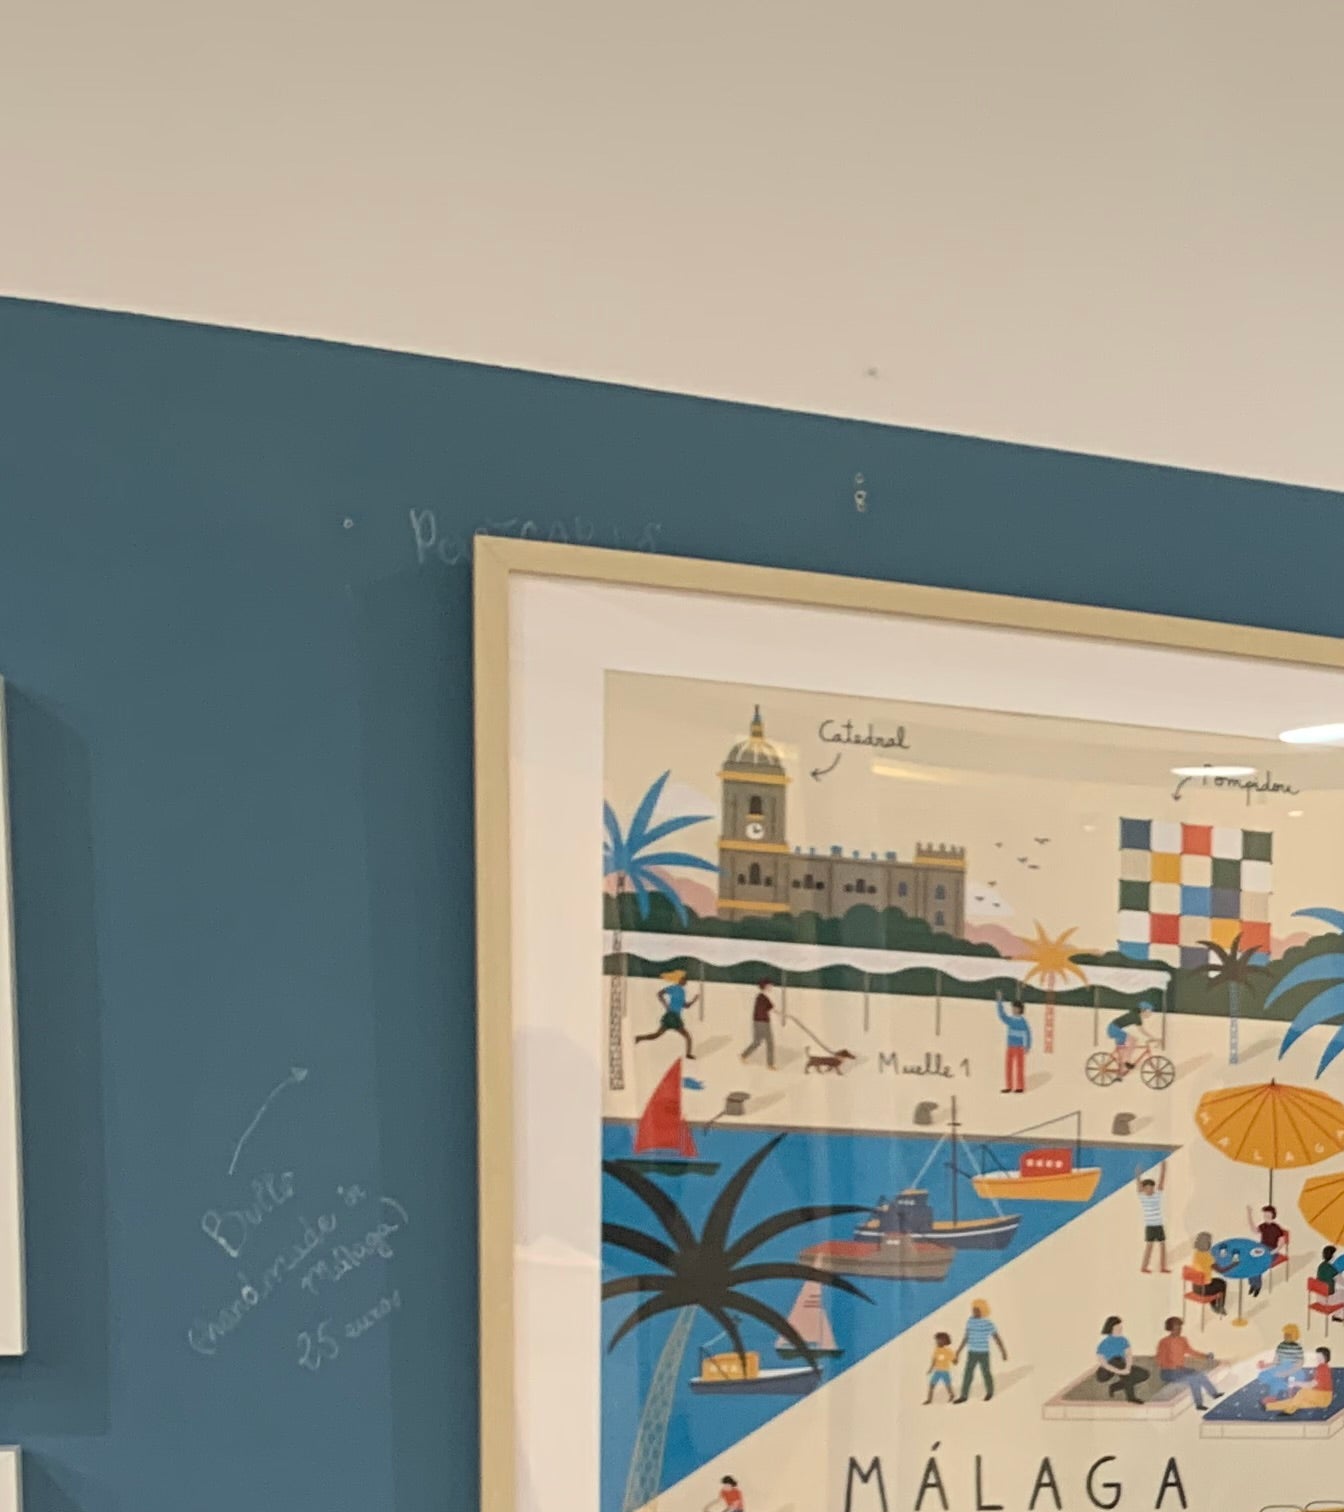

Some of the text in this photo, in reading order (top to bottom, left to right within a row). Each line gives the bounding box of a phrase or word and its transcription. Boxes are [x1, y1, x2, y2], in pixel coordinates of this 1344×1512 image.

[818, 719, 911, 749] Catedral
[878, 1051, 970, 1078] Muelle 1
